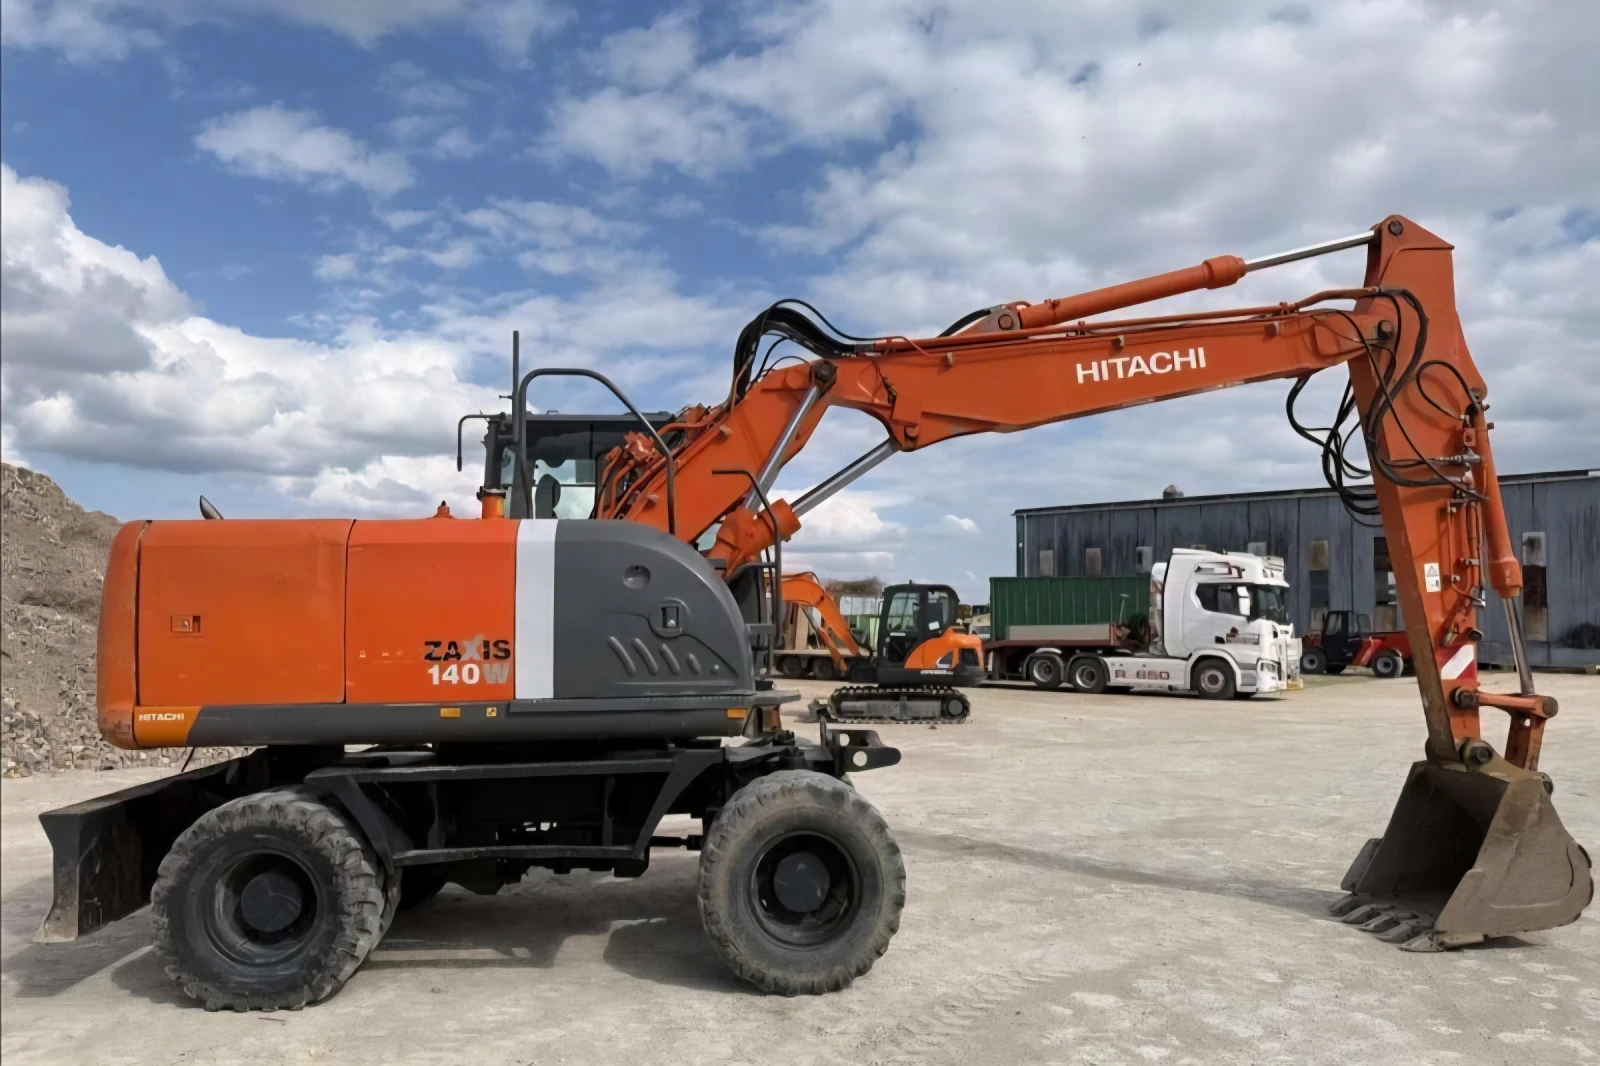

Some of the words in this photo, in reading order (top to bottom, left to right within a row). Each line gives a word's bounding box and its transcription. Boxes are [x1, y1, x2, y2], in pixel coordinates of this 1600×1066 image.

[1076, 347, 1206, 384] HITACHI
[424, 633, 511, 661] ZAXIS
[427, 663, 510, 685] 140W
[138, 712, 185, 721] HITACHI
